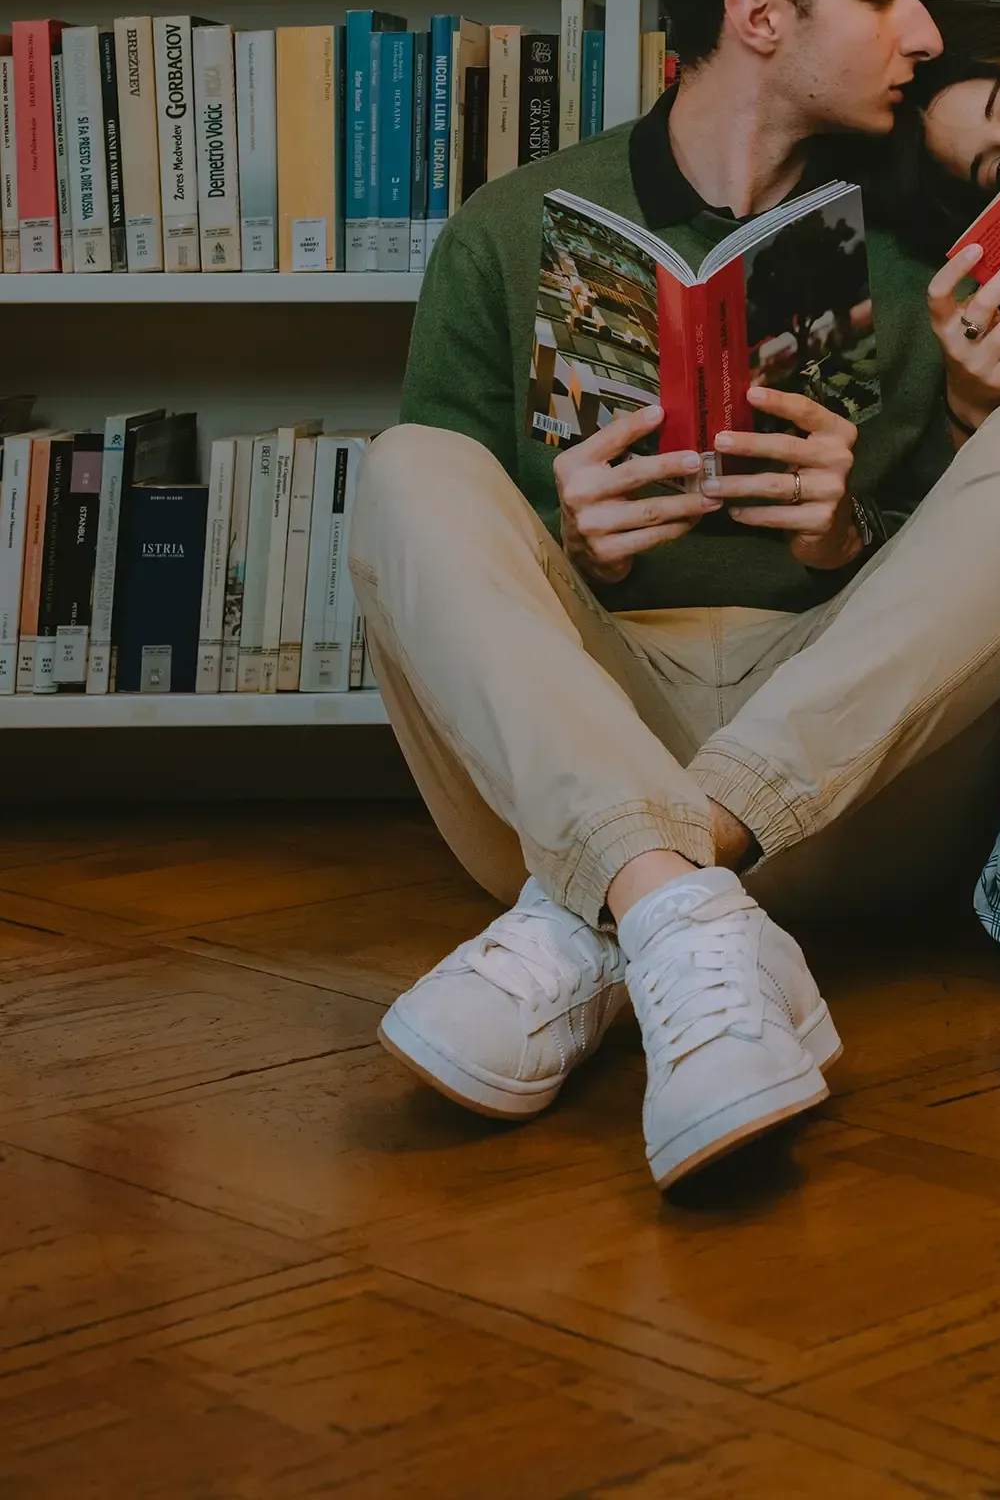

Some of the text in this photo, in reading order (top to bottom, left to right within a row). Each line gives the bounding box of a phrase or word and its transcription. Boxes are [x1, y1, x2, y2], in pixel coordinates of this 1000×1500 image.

[126, 28, 141, 97] BREŽNEV
[165, 23, 187, 119] GORBACIOV
[77, 116, 89, 124] SI
[433, 55, 447, 189] NICOLAI LILIN UCRAINA
[529, 98, 542, 148] GRANDI
[542, 99, 550, 118] VITA
[78, 126, 89, 136] FA
[541, 126, 550, 154] MORTE
[78, 138, 91, 165] PRESTO
[173, 125, 184, 170] Medvedev
[204, 104, 225, 197] Demetrio Volcic
[80, 175, 93, 191] DIRE
[81, 193, 94, 220] RUSSIA
[721, 350, 729, 401] happiness
[260, 446, 271, 476] BELOFF
[76, 506, 87, 544] ISTANBUL
[141, 543, 185, 554] ISTRIA
